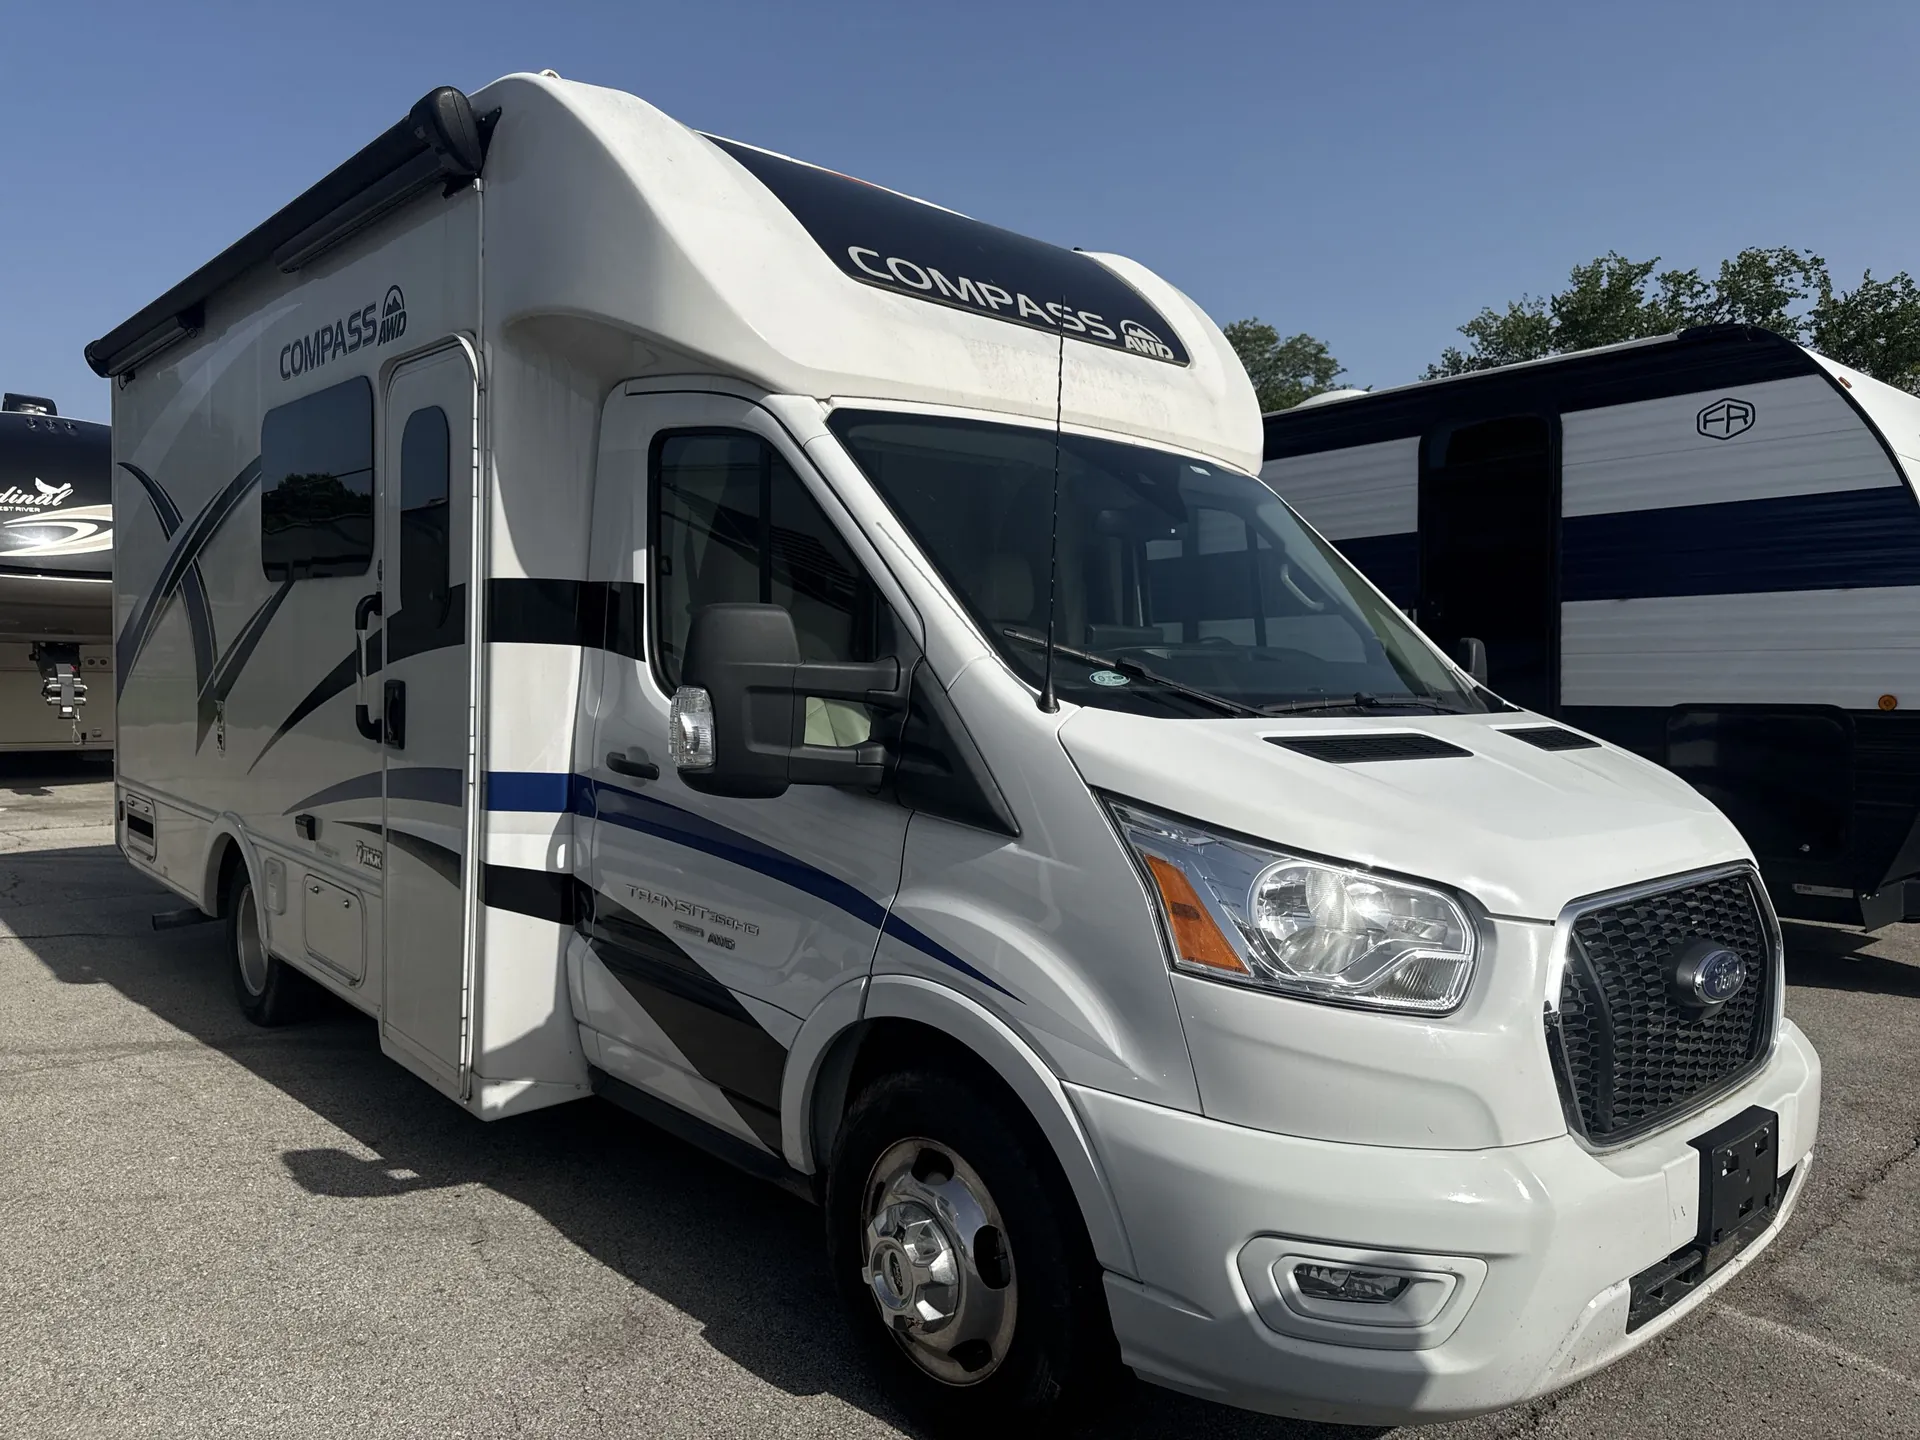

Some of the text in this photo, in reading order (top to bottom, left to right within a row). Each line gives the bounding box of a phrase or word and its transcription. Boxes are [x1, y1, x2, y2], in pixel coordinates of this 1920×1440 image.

[847, 246, 1175, 360] COMPASS AWD
[279, 302, 407, 380] COMPASS AWD
[626, 884, 709, 919] TRANSIT
[707, 932, 736, 951] AWD
